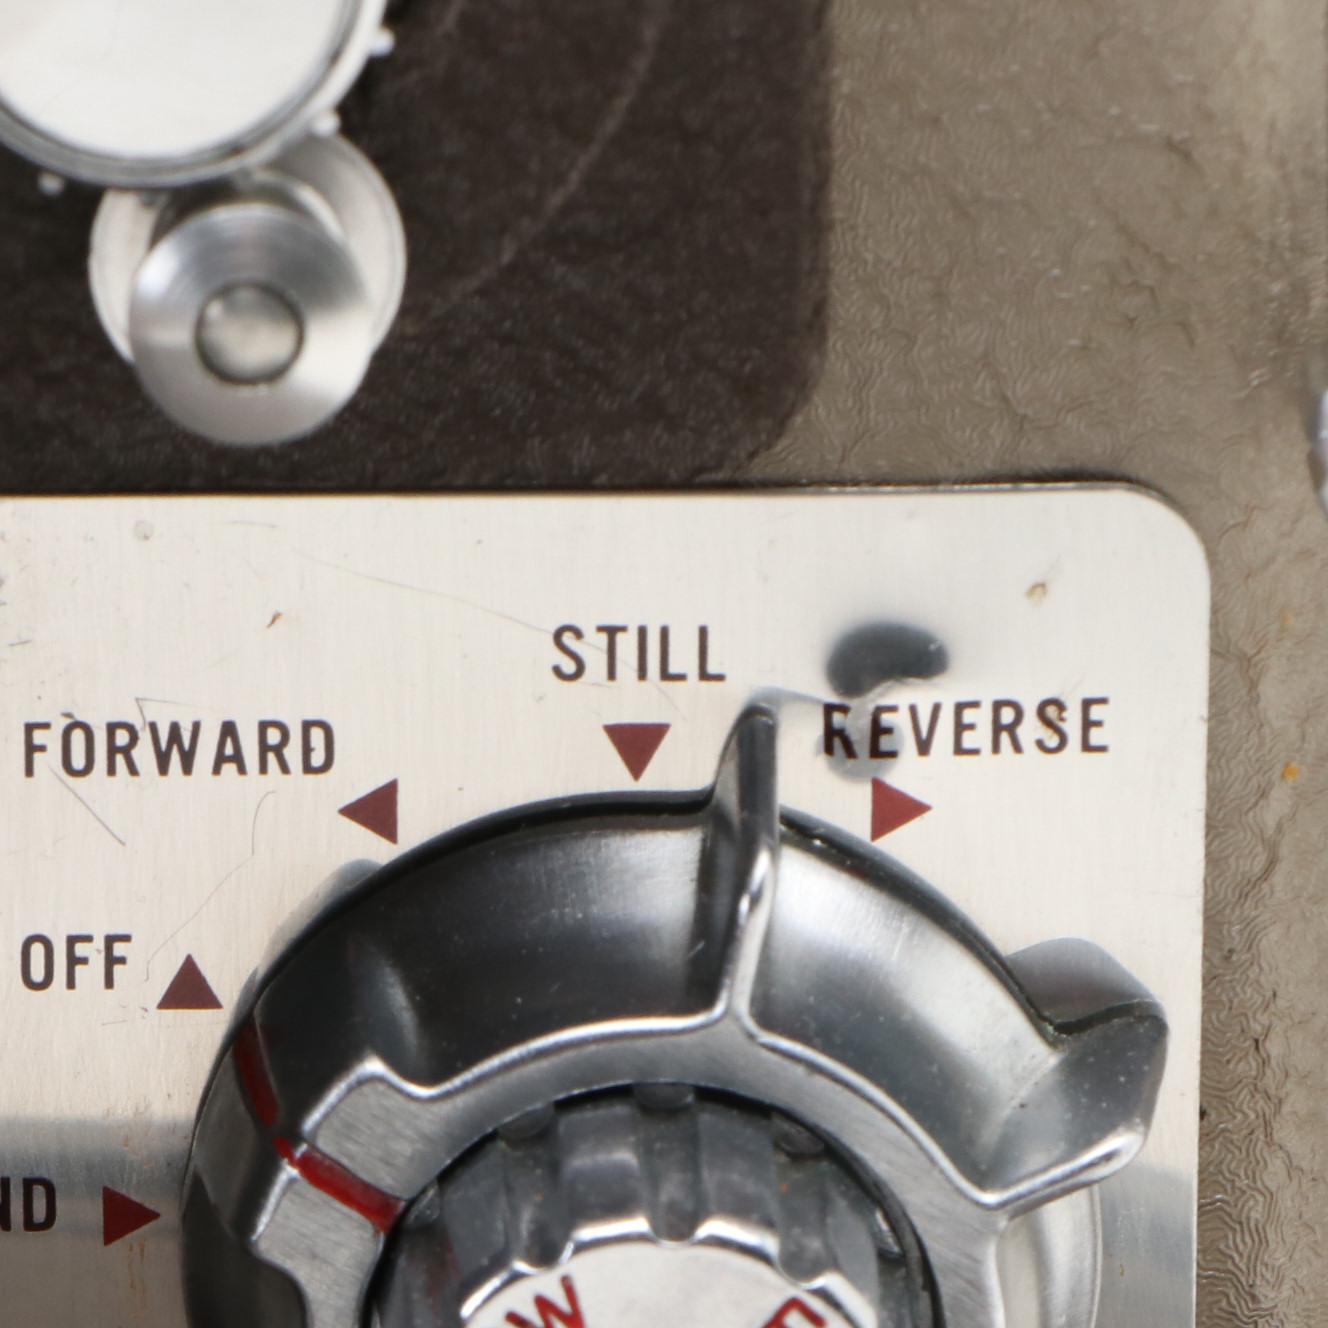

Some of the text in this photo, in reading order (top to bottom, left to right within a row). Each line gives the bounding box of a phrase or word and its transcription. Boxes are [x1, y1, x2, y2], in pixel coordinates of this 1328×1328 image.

[552, 624, 727, 683] STILL
[23, 718, 336, 779] FORWARD
[822, 697, 1110, 760] REVERSE
[20, 933, 133, 992] OFF
